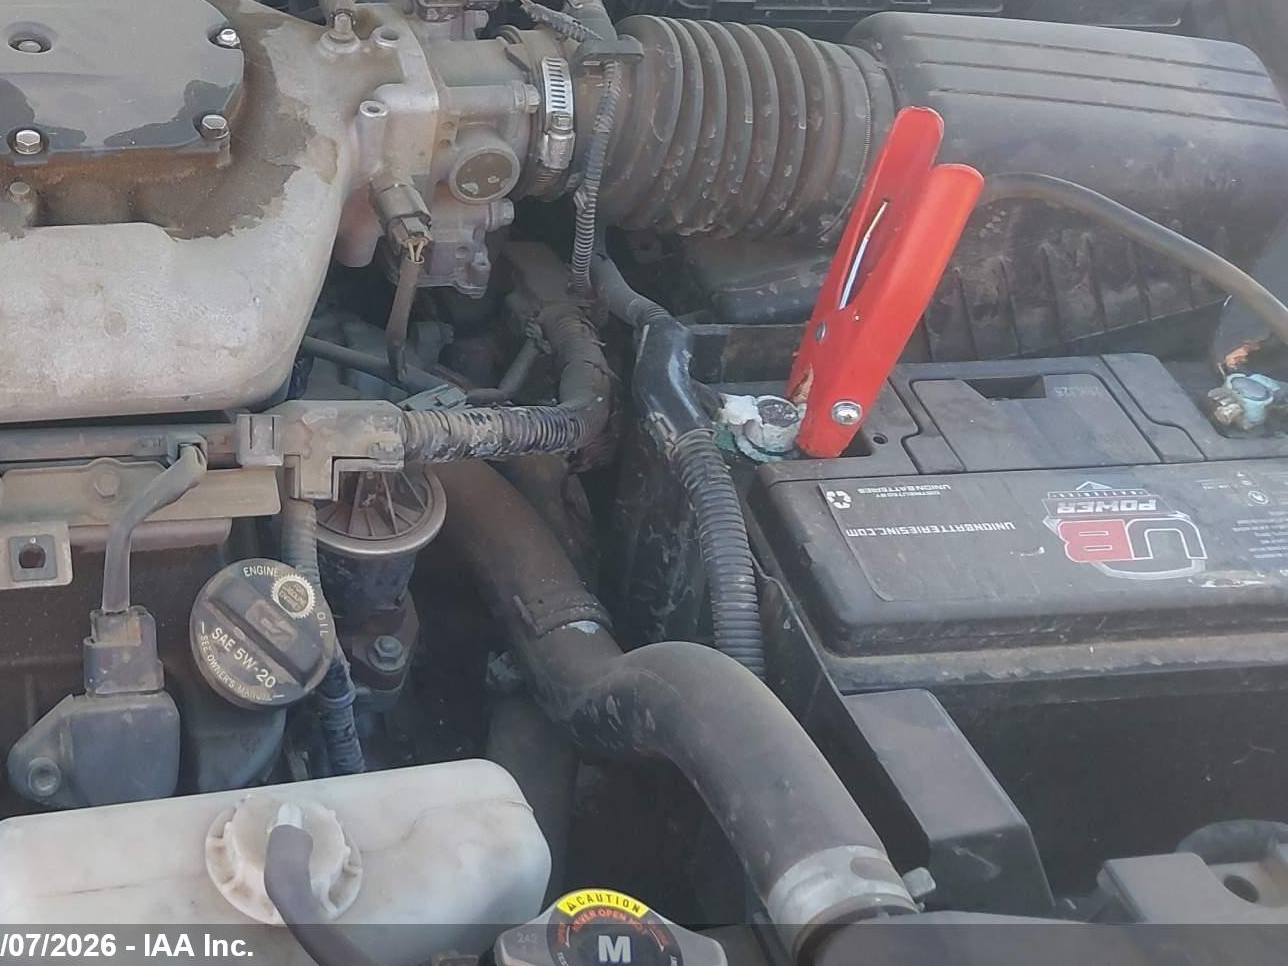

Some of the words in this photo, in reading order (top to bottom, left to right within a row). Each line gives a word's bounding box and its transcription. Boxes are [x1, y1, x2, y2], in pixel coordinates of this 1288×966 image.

[1056, 499, 1157, 514] POWER
[242, 564, 281, 578] ENGINE
[316, 611, 329, 637] OIL
[211, 626, 237, 653] SAE
[233, 648, 277, 689] 5W-20
[576, 893, 641, 913] CAUTION
[597, 935, 632, 965] M
